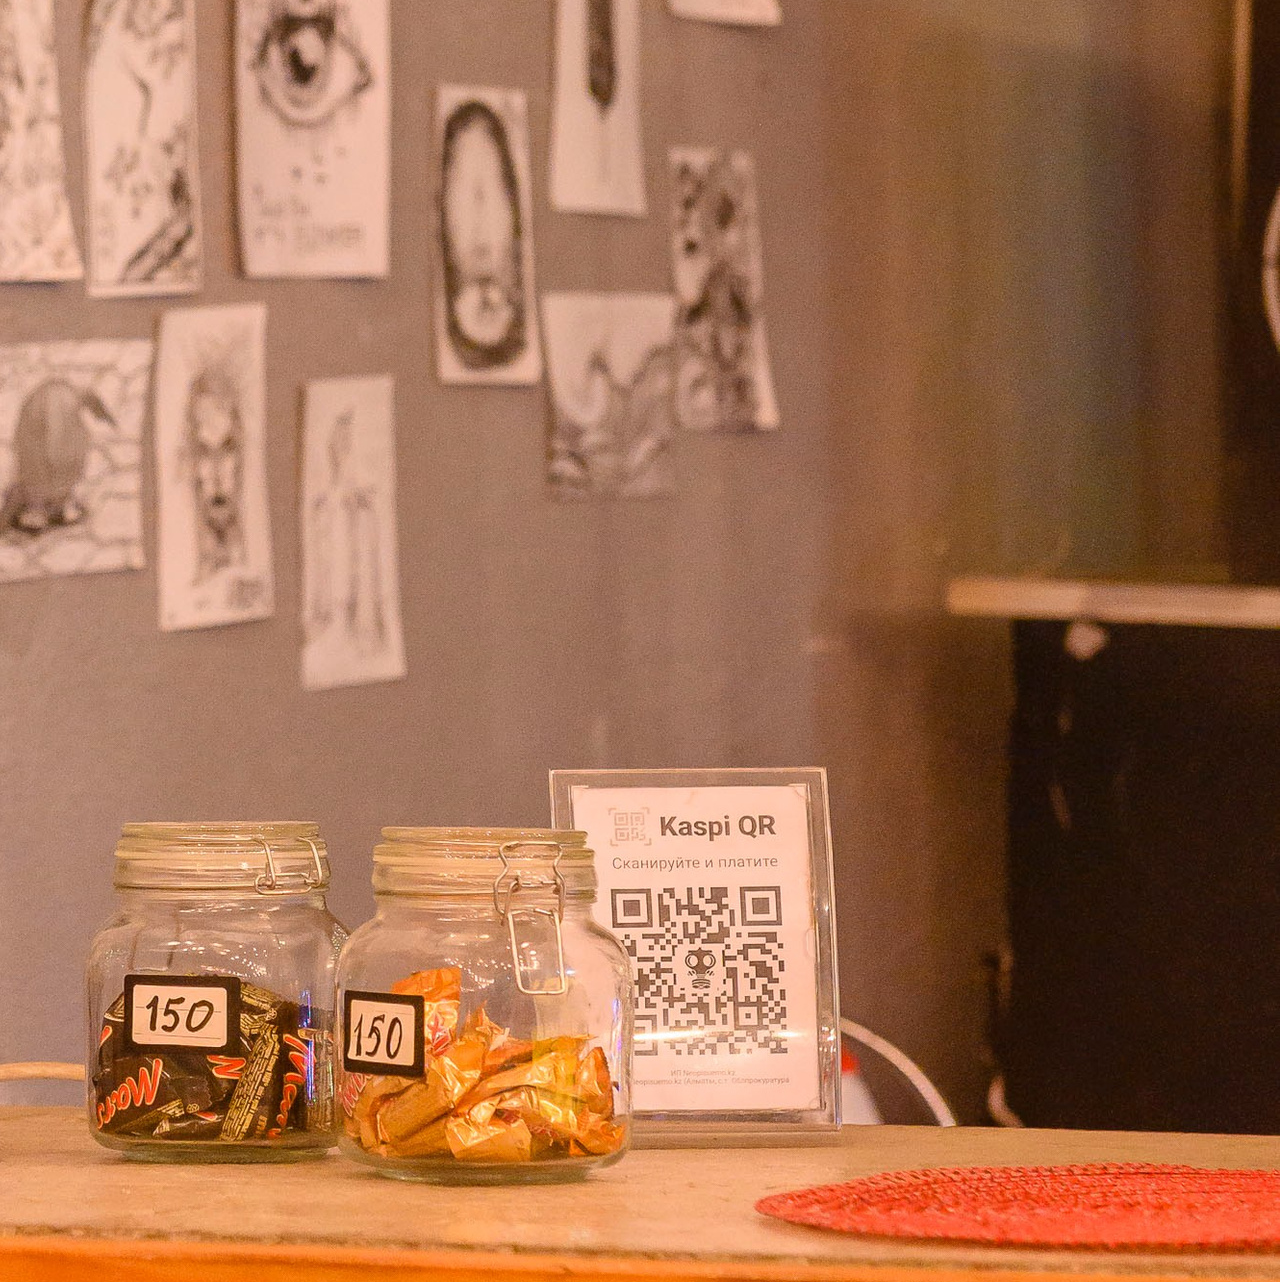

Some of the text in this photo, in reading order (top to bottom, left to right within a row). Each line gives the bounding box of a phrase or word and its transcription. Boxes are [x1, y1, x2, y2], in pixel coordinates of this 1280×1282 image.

[659, 815, 777, 842] Kaspi QR
[612, 856, 778, 873] Сканируйте и платите
[146, 995, 214, 1032] 150
[354, 1013, 402, 1059] 150
[97, 1058, 163, 1129] Mars
